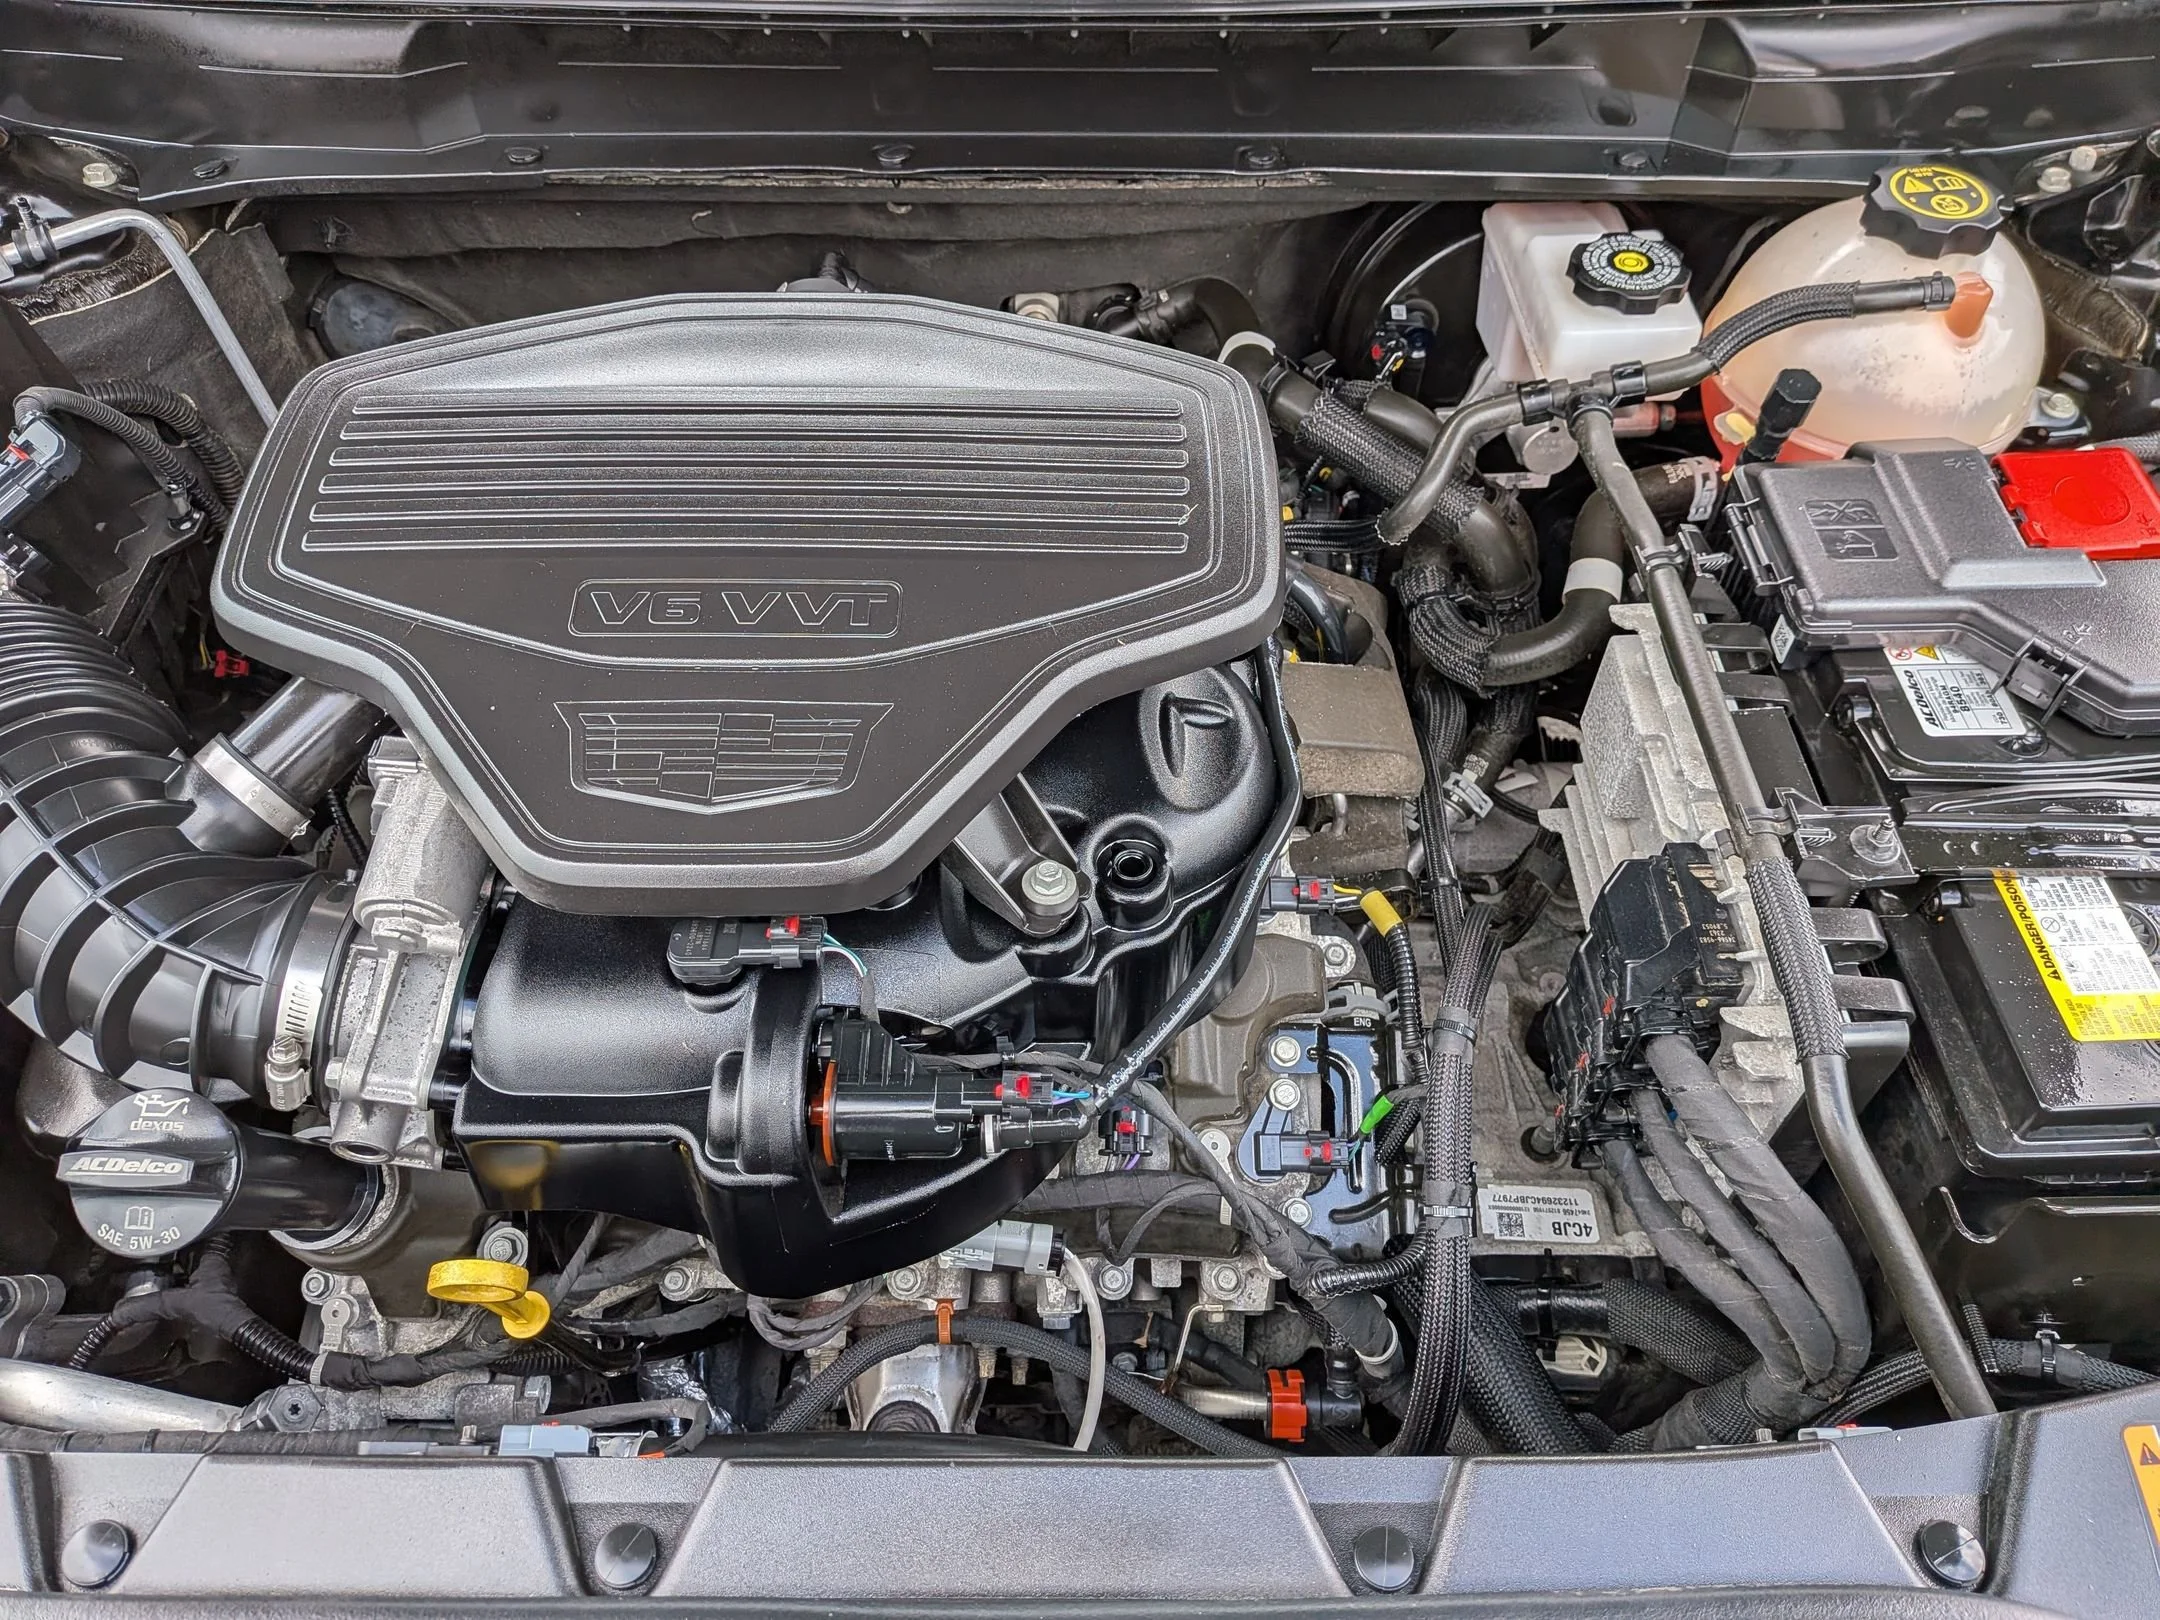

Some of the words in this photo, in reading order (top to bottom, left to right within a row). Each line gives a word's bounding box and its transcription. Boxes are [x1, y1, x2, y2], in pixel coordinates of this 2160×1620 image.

[590, 592, 701, 625] V6
[721, 592, 888, 626] VVT
[1904, 669, 1939, 728] ACDelco
[1950, 685, 1970, 713] 8540
[1354, 1017, 1371, 1027] ENG
[130, 1117, 184, 1132] dexos
[70, 1156, 183, 1174] ACDelco
[1492, 1194, 1579, 1207] 11232694CJBP7977
[97, 1223, 124, 1247] SAE
[129, 1226, 181, 1250] 5W-30
[1552, 1221, 1593, 1238] 4CJB
